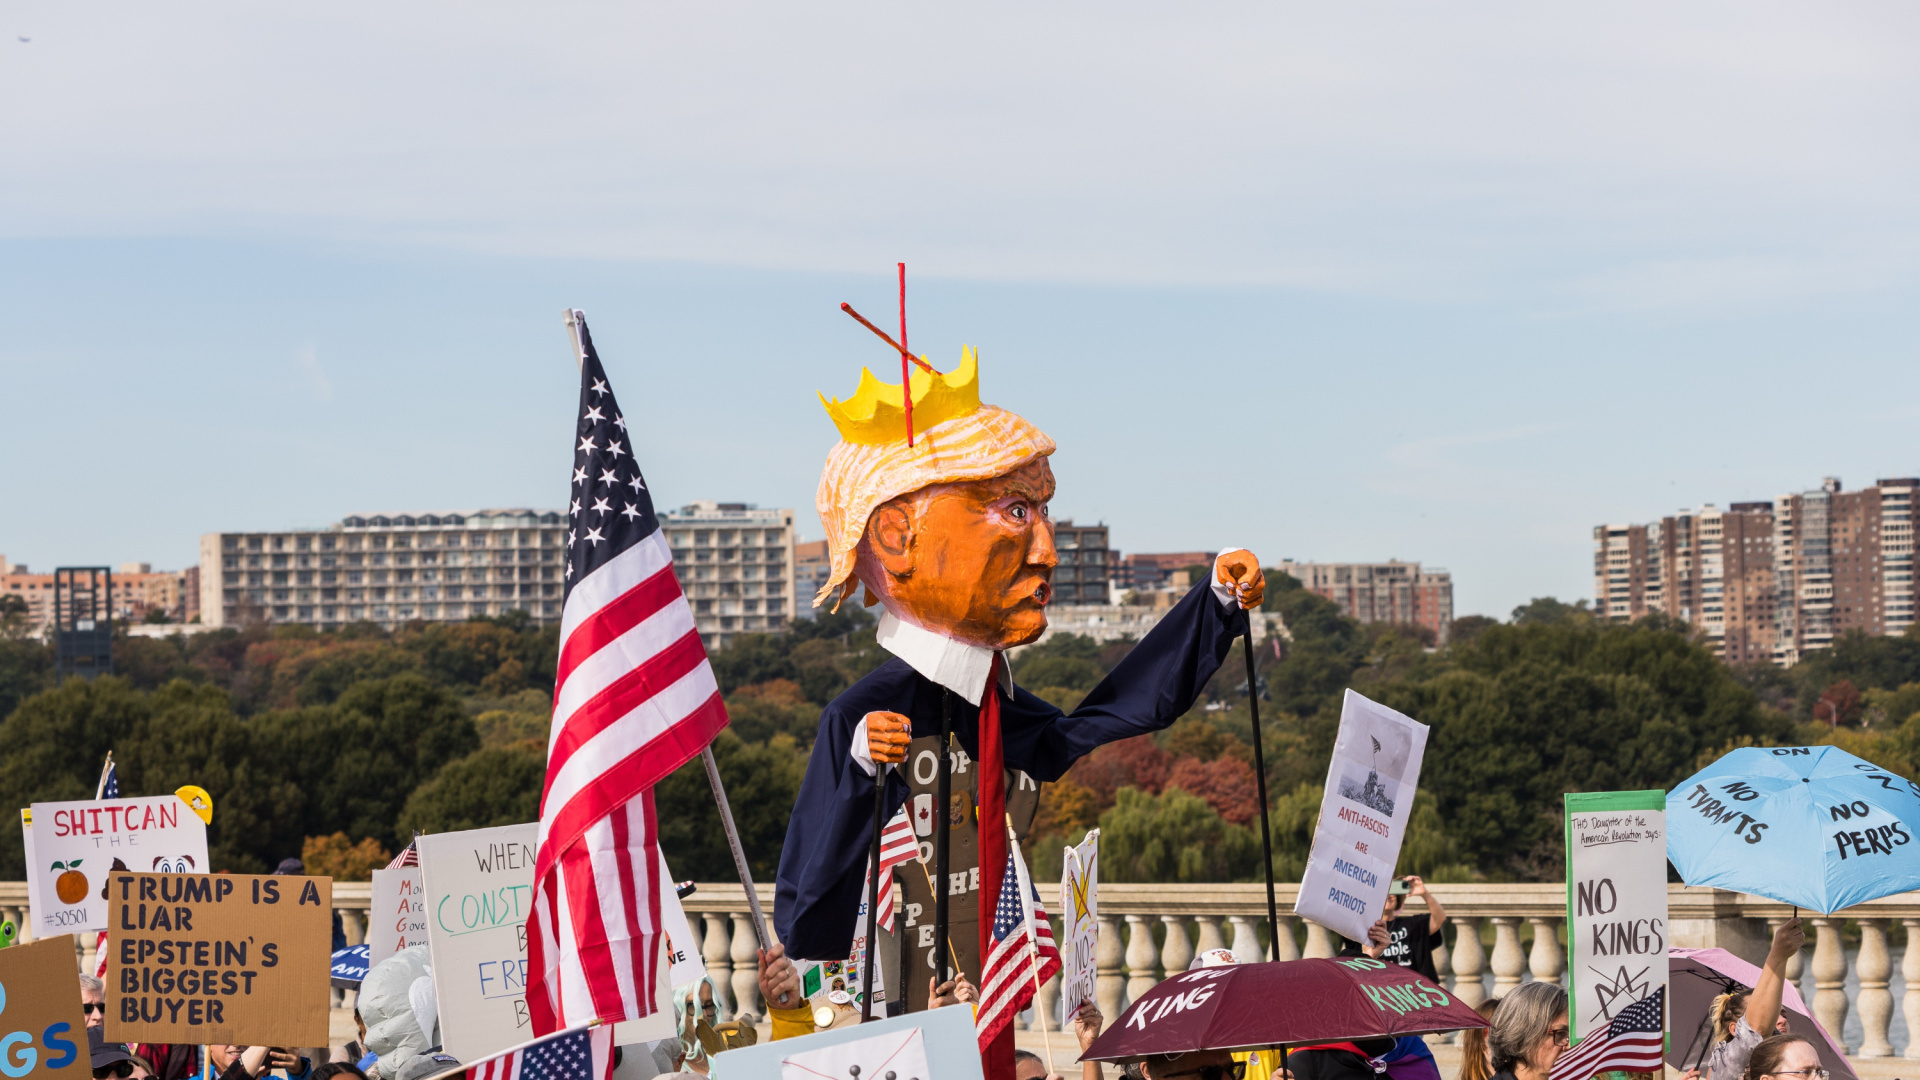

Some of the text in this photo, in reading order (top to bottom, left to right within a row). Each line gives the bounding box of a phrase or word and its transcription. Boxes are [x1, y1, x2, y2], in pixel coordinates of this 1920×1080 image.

[1720, 782, 1759, 802] NO
[54, 802, 177, 837] SHITCAN
[1338, 806, 1389, 838] ANTI-FASCISTS
[1624, 815, 1632, 827] of
[1635, 815, 1646, 827] the
[1687, 784, 1769, 845] TYRANTS
[1830, 800, 1870, 822] NO
[92, 834, 139, 848] THE
[1355, 841, 1368, 855] ARE
[1581, 832, 1609, 844] American
[1833, 821, 1910, 860] PERPS
[474, 843, 536, 873] WHEN
[1333, 857, 1377, 888] AMERICAN
[117, 876, 321, 906] TRUMP IS A
[1328, 887, 1366, 915] PATRIOTS
[1578, 878, 1617, 917] NO
[44, 908, 87, 926] #50501
[122, 903, 193, 932] LIAR
[438, 885, 533, 933] CONST
[121, 936, 279, 968] EPSTEIN'S
[1593, 918, 1663, 956] KINGS
[1075, 935, 1089, 976] NO
[121, 967, 258, 995] BIGGEST
[1069, 969, 1094, 1014] KINGS
[121, 997, 224, 1026] BUYER
[1125, 983, 1217, 1032] KING
[1360, 980, 1450, 1017] KINGS
